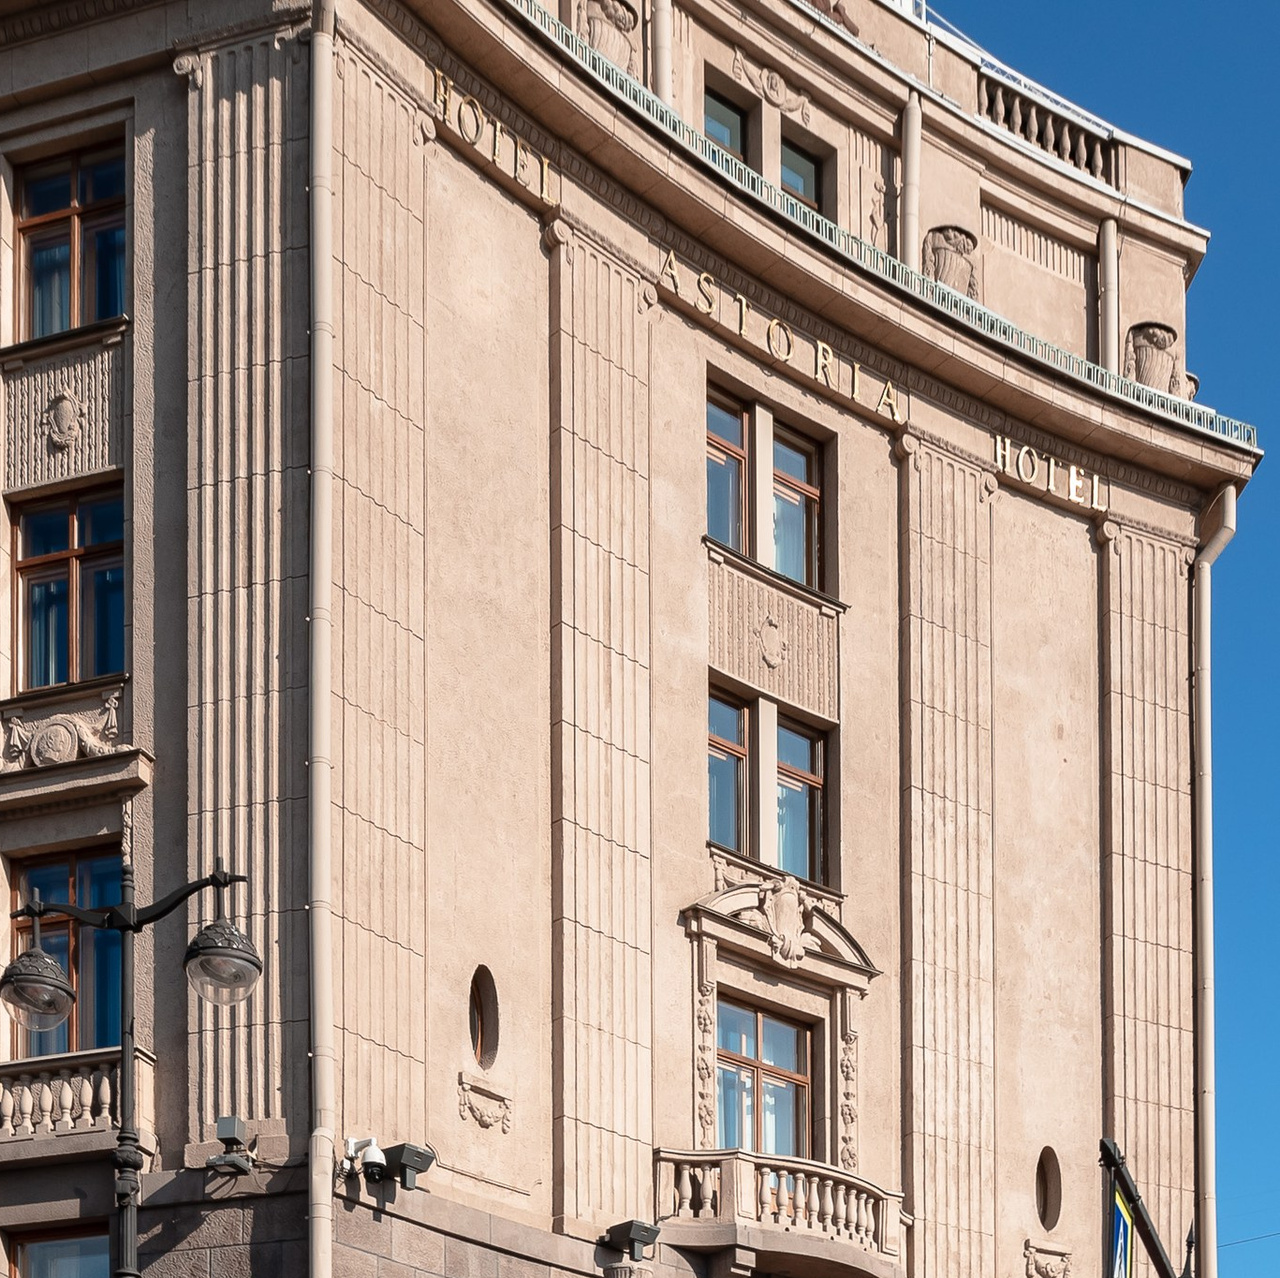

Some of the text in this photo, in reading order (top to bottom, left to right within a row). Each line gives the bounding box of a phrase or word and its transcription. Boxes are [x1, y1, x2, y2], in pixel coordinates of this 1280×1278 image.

[435, 67, 1108, 512] HOTEL ASTORIA HOTEL
